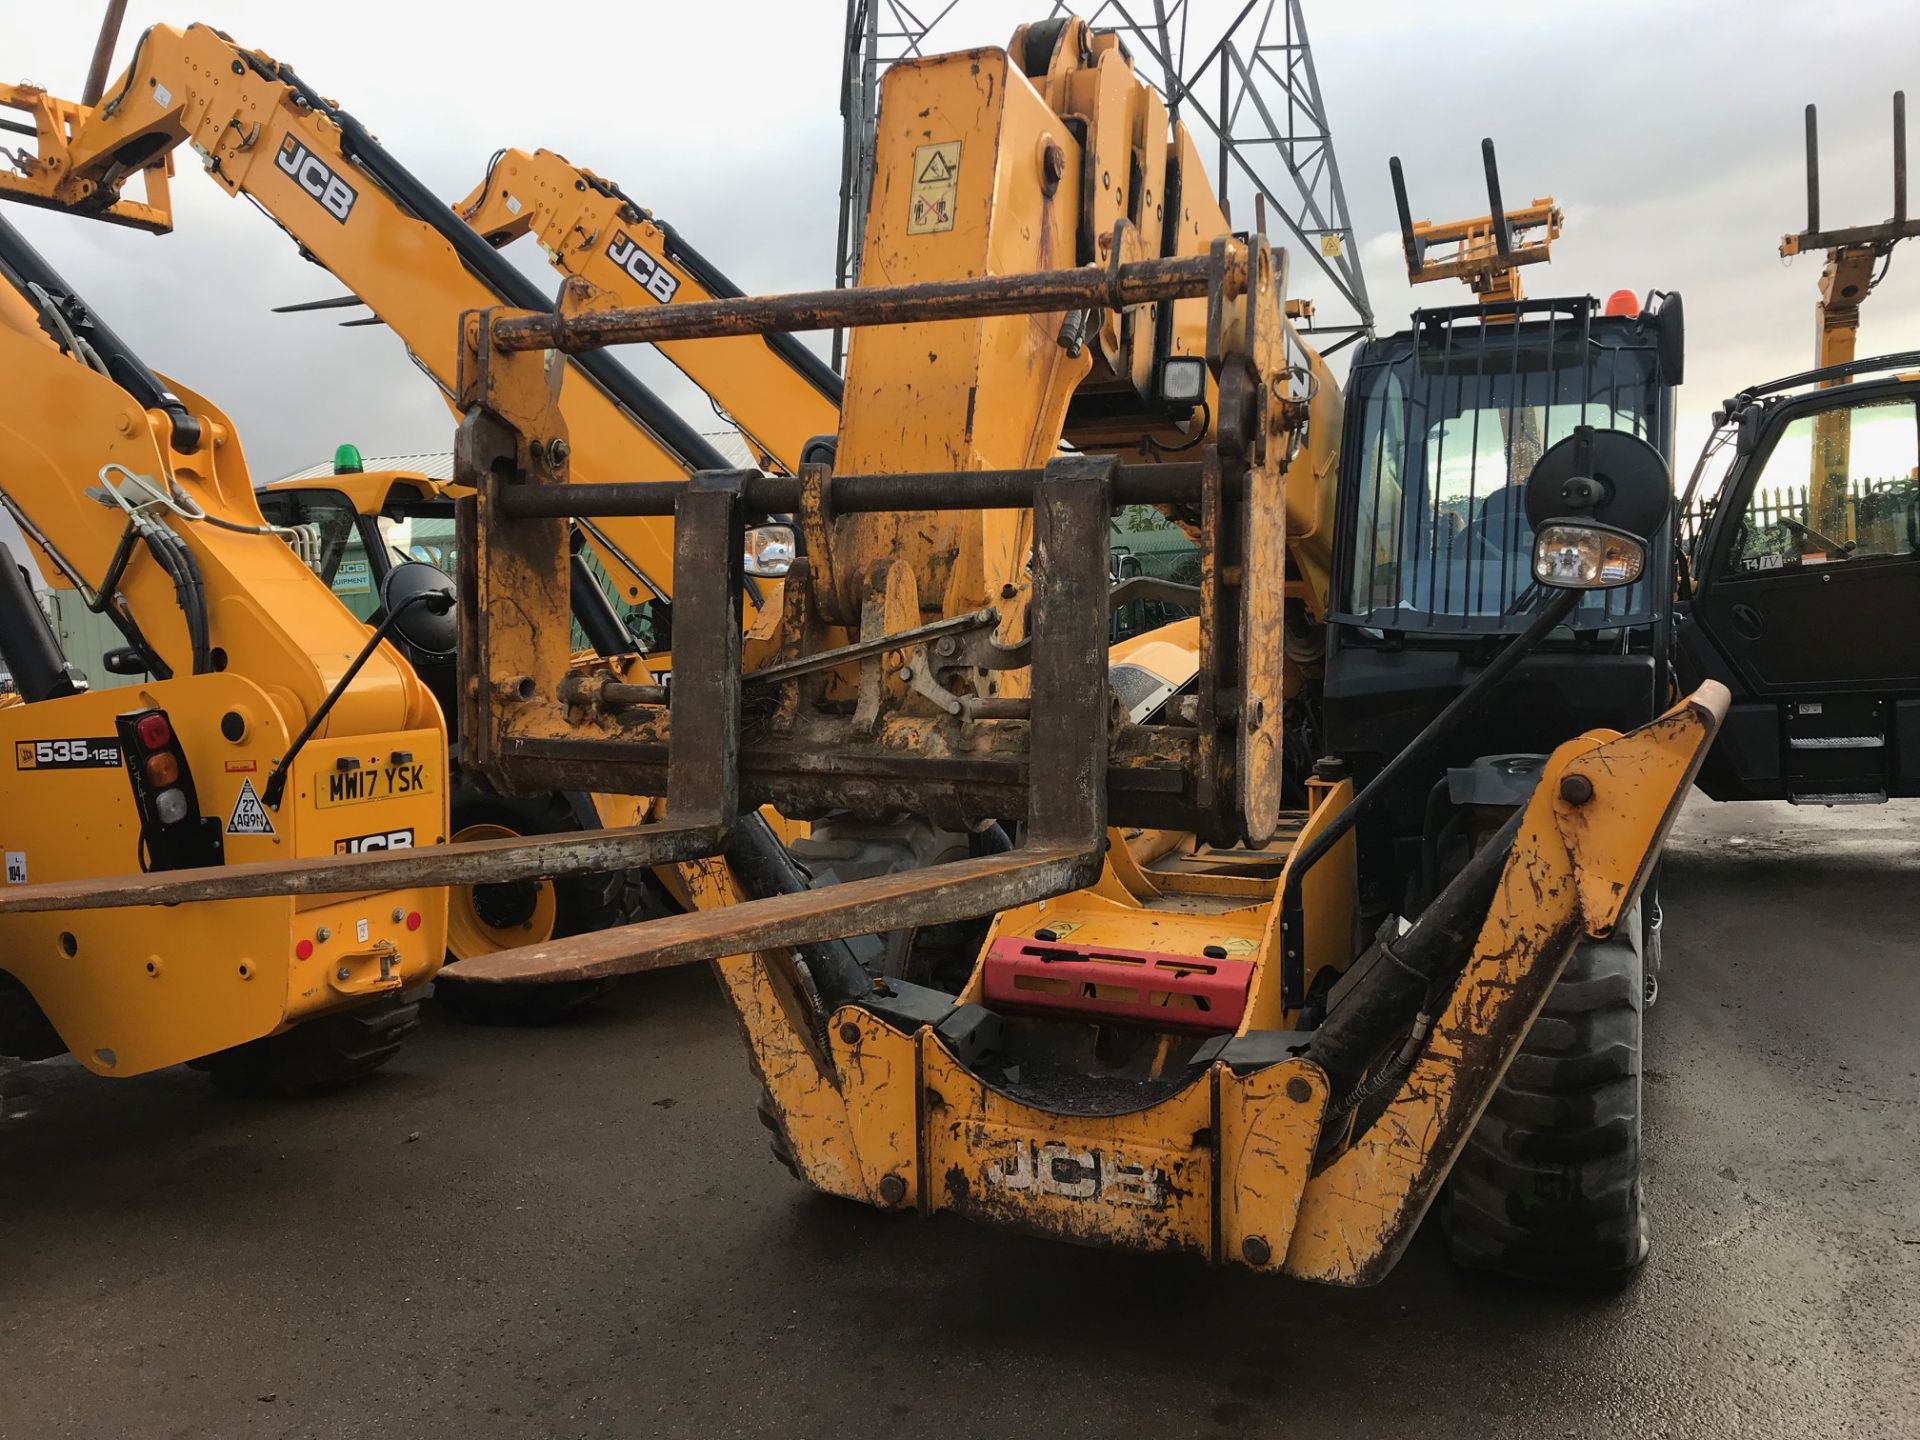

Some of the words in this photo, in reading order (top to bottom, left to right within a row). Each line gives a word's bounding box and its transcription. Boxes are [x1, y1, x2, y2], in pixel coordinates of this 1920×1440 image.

[278, 146, 354, 219] JCB
[608, 241, 677, 304] JCB
[338, 564, 365, 573] JCB
[1743, 558, 1759, 571] T4
[1763, 556, 1779, 568] IV
[36, 740, 118, 762] 535-125
[329, 769, 378, 802] MW17
[384, 764, 424, 794] YSK
[242, 799, 255, 813] 27
[236, 813, 264, 827] AQ9N
[988, 1141, 1159, 1205] JCB
